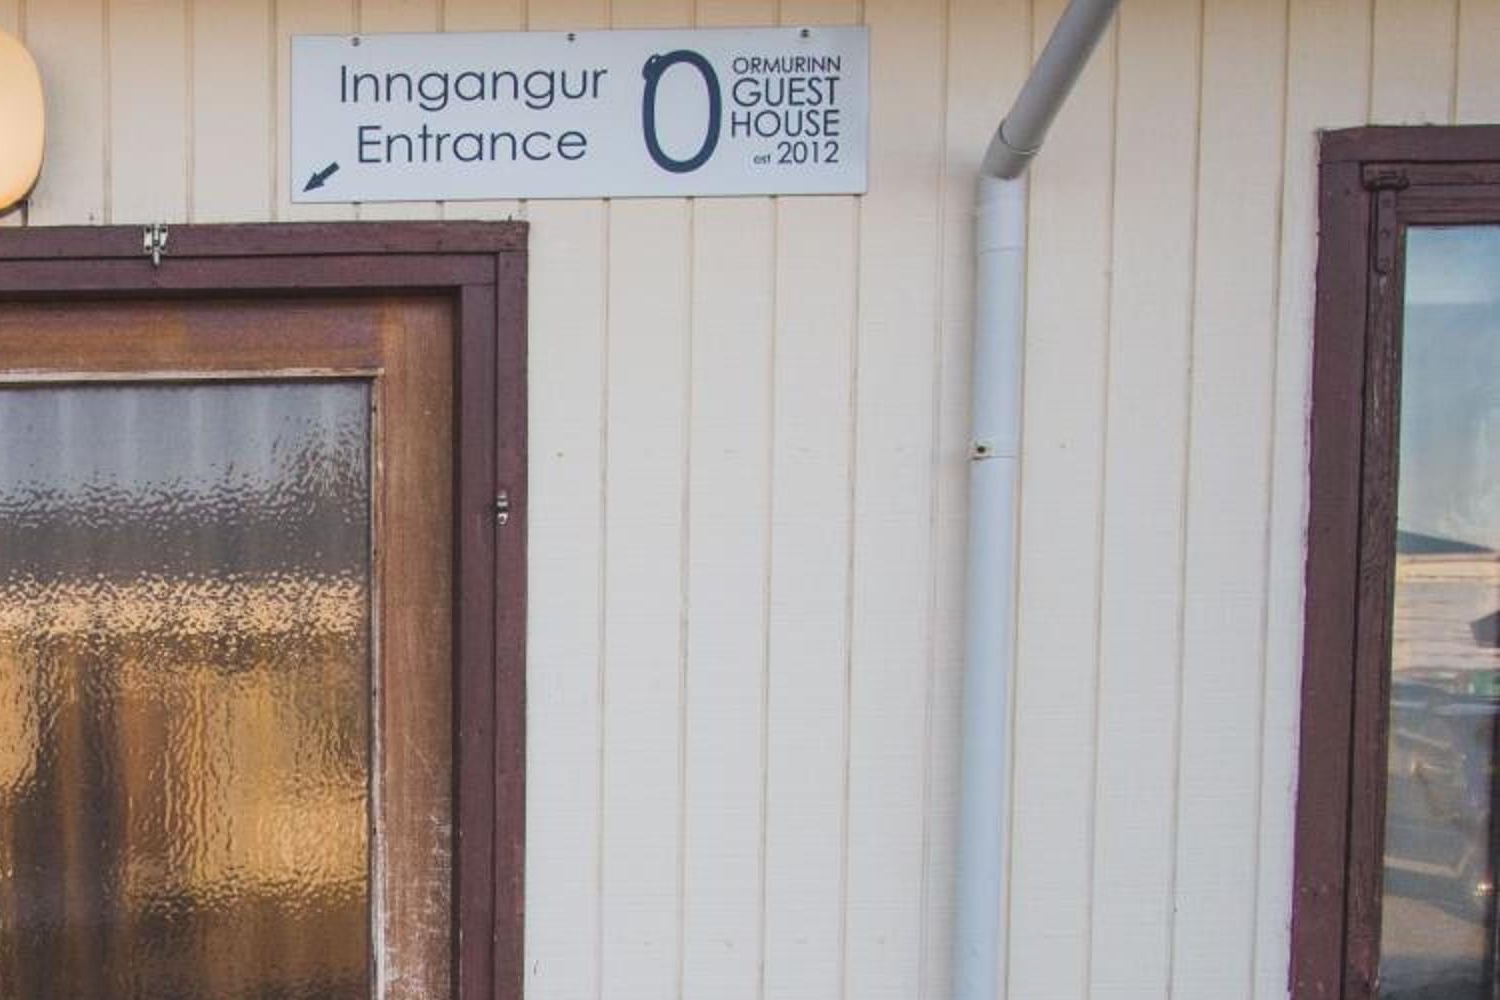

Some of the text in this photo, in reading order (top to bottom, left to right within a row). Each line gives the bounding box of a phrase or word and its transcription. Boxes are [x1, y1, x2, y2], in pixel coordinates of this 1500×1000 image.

[732, 56, 841, 74] ORMURINN
[341, 64, 607, 111] Inngangur
[732, 76, 841, 107] GUEST
[731, 109, 840, 138] HOUSE
[358, 124, 587, 163] Entrance
[753, 142, 840, 165] est 2012
